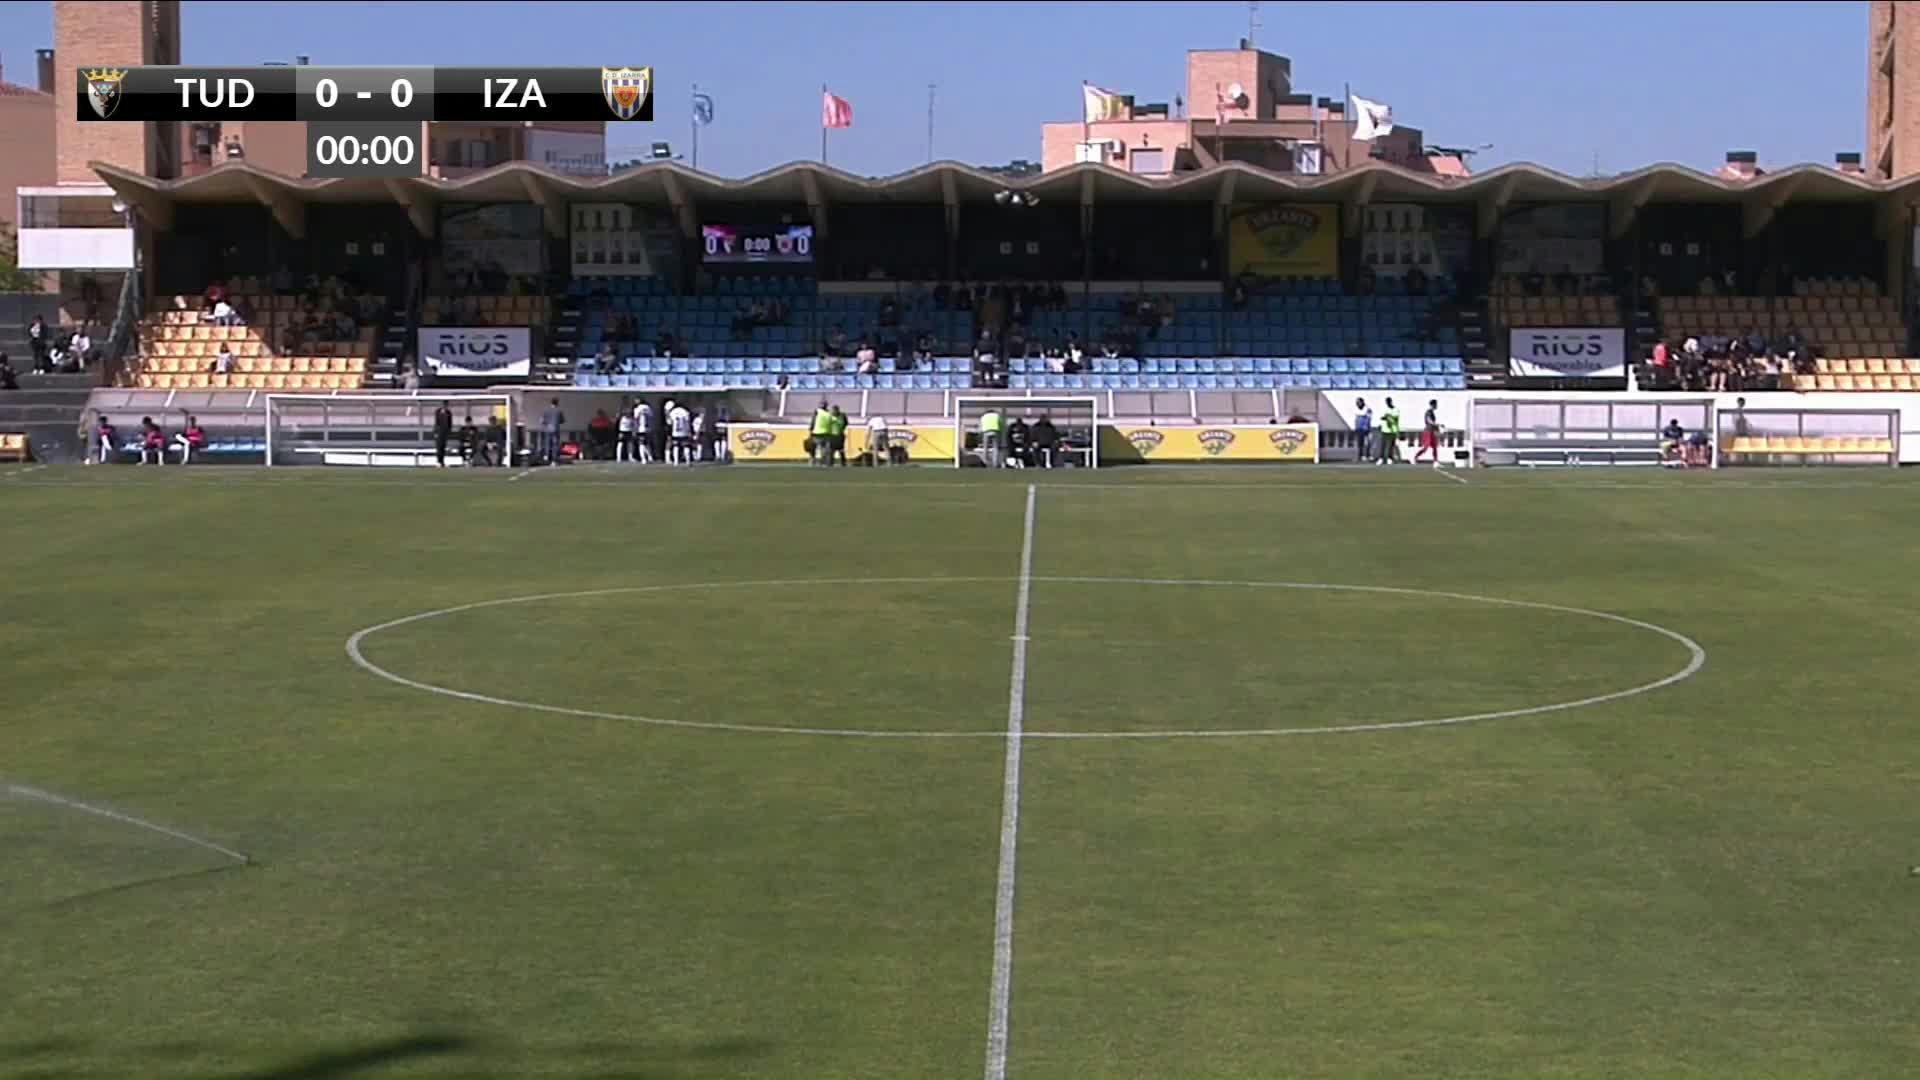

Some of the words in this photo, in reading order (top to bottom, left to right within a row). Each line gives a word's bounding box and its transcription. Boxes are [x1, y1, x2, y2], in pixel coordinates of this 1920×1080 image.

[705, 234, 718, 255] 0
[744, 237, 771, 252] 0:00
[797, 233, 810, 255] 0
